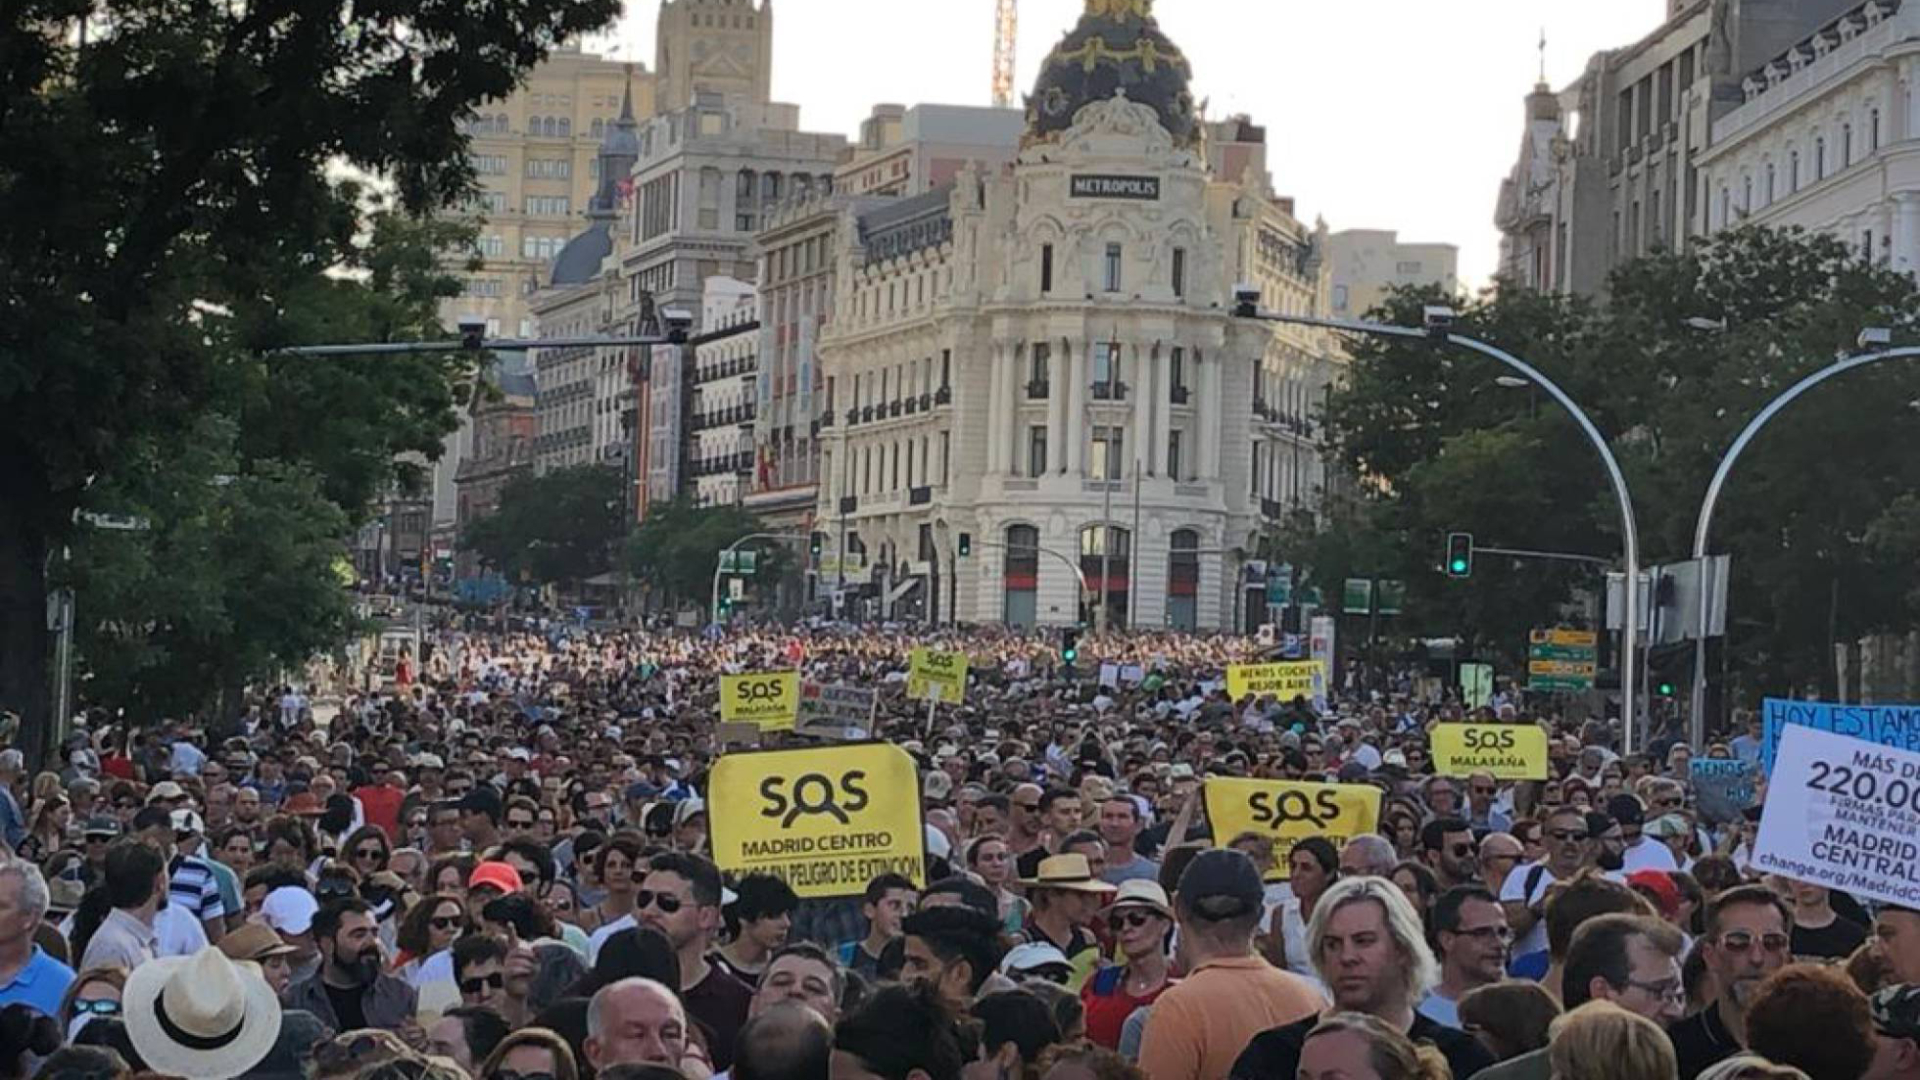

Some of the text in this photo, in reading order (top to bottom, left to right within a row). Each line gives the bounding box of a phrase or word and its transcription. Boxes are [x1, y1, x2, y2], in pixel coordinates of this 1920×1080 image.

[1074, 178, 1156, 194] METROPOLIS
[926, 651, 954, 669] SOS
[737, 679, 783, 702] SOS
[1771, 702, 1817, 727] HOY
[1464, 728, 1515, 754] SOS
[760, 770, 868, 828] SOS
[1249, 789, 1341, 829] SOS
[742, 831, 892, 857] MADRID CENTRO
[1824, 824, 1917, 861] MADRID
[789, 860, 838, 887] PELIGRO
[841, 859, 857, 884] DE
[1812, 842, 1920, 883] CENTRAL
